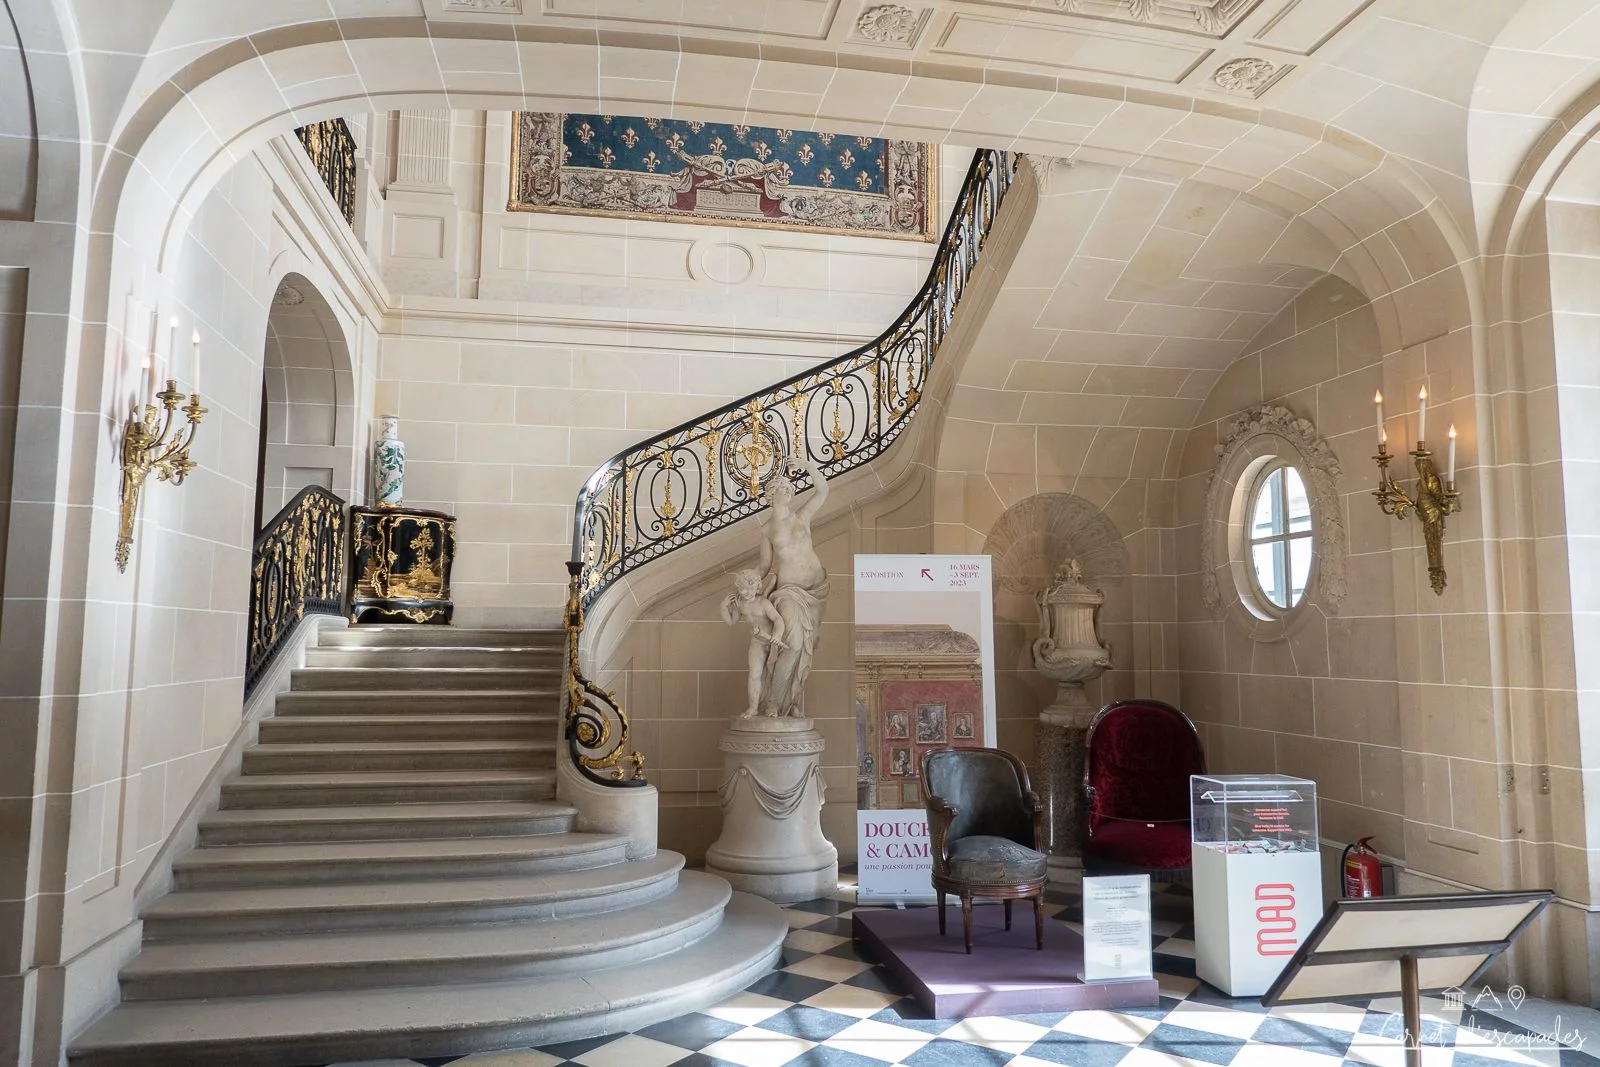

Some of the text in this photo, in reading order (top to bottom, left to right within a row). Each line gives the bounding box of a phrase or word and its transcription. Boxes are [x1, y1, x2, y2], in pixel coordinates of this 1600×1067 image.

[860, 571, 904, 579] EXPOSITION
[866, 842, 881, 859] &
[882, 862, 914, 871] passion
